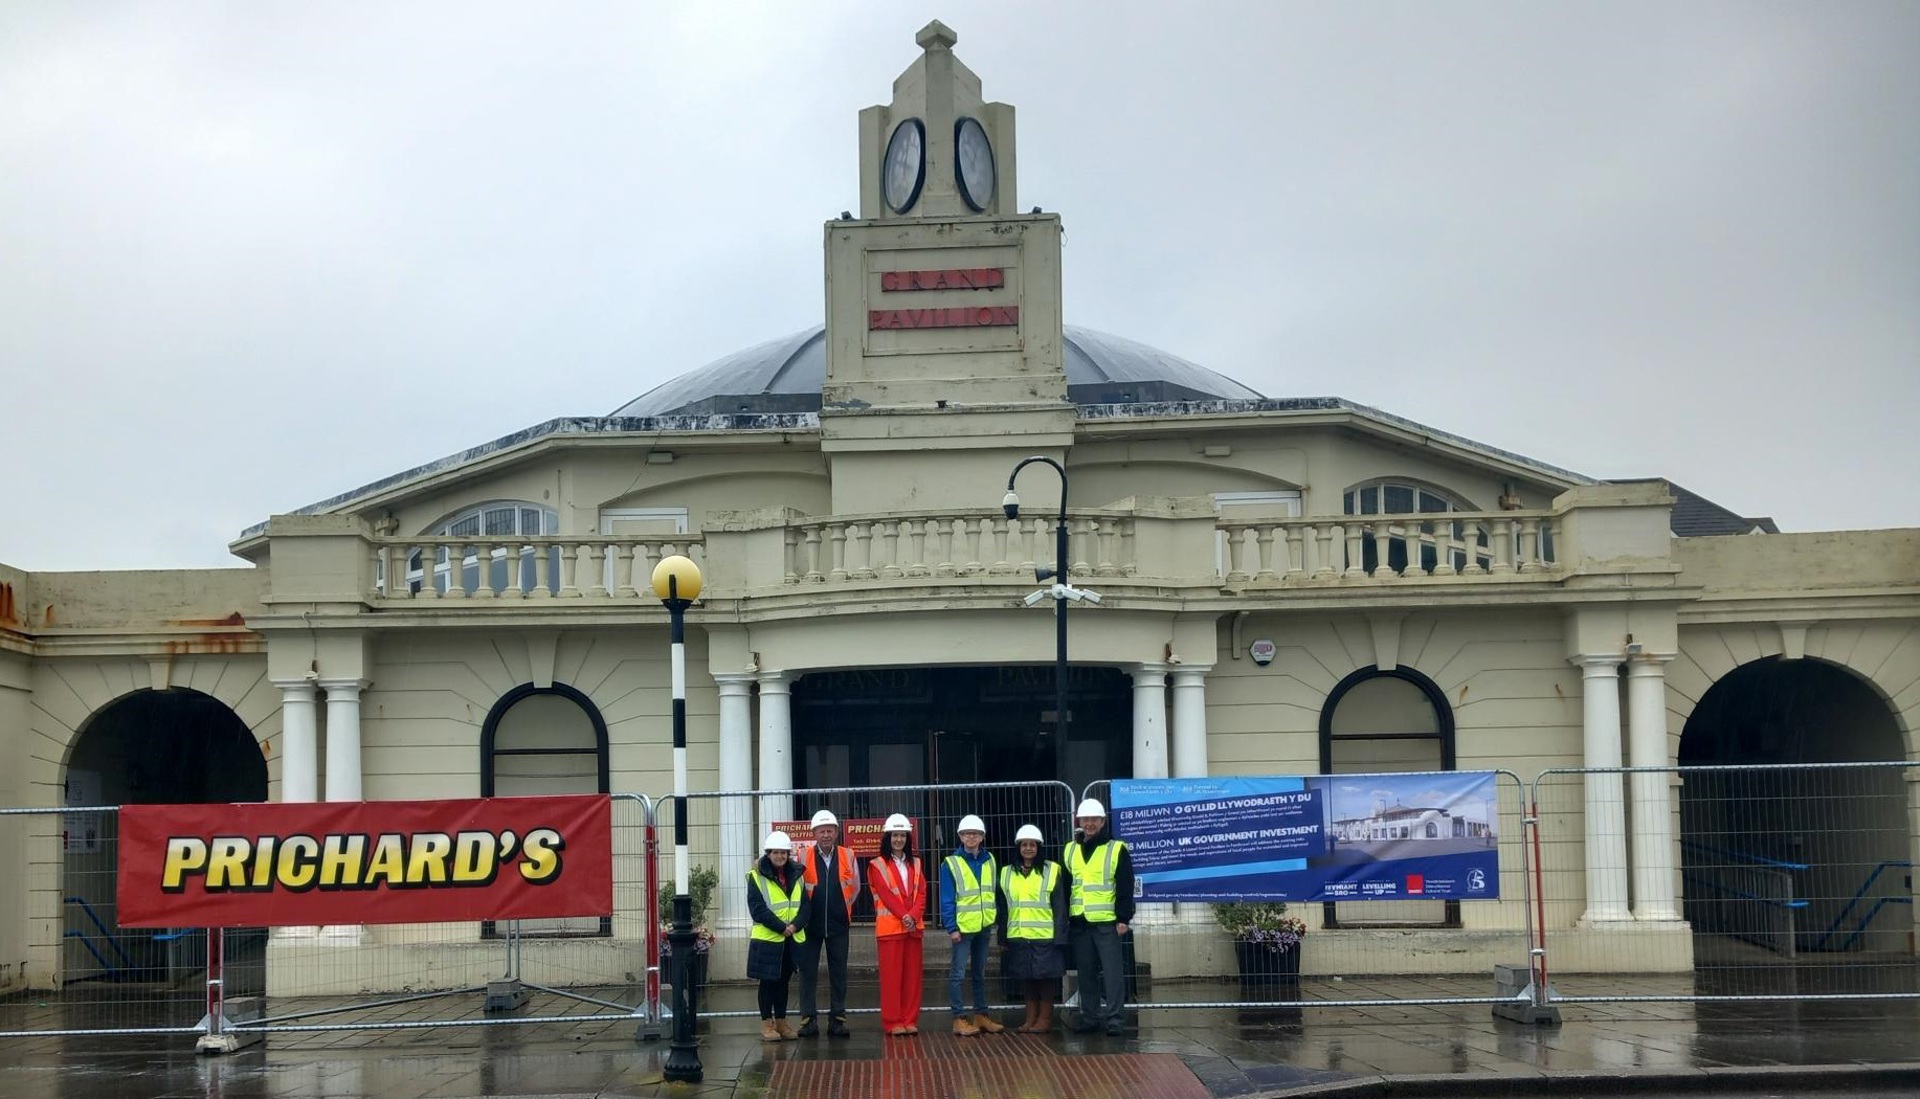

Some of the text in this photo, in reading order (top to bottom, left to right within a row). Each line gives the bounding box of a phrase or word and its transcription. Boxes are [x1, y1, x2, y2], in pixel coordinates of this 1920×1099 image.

[884, 268, 1004, 290] GRAND
[871, 306, 1018, 329] PAVILION
[998, 667, 1114, 687] PAVIION
[1174, 806, 1183, 814] O
[1217, 796, 1288, 809] LLYWODRAETH
[1289, 795, 1296, 803] Y
[1298, 793, 1311, 802] DU
[1136, 839, 1174, 850] MILLION
[1178, 837, 1192, 846] UK
[1193, 830, 1258, 844] GOVERNMENT
[1259, 824, 1319, 838] INVESTMENT
[161, 828, 565, 893] PRICHARD'S
